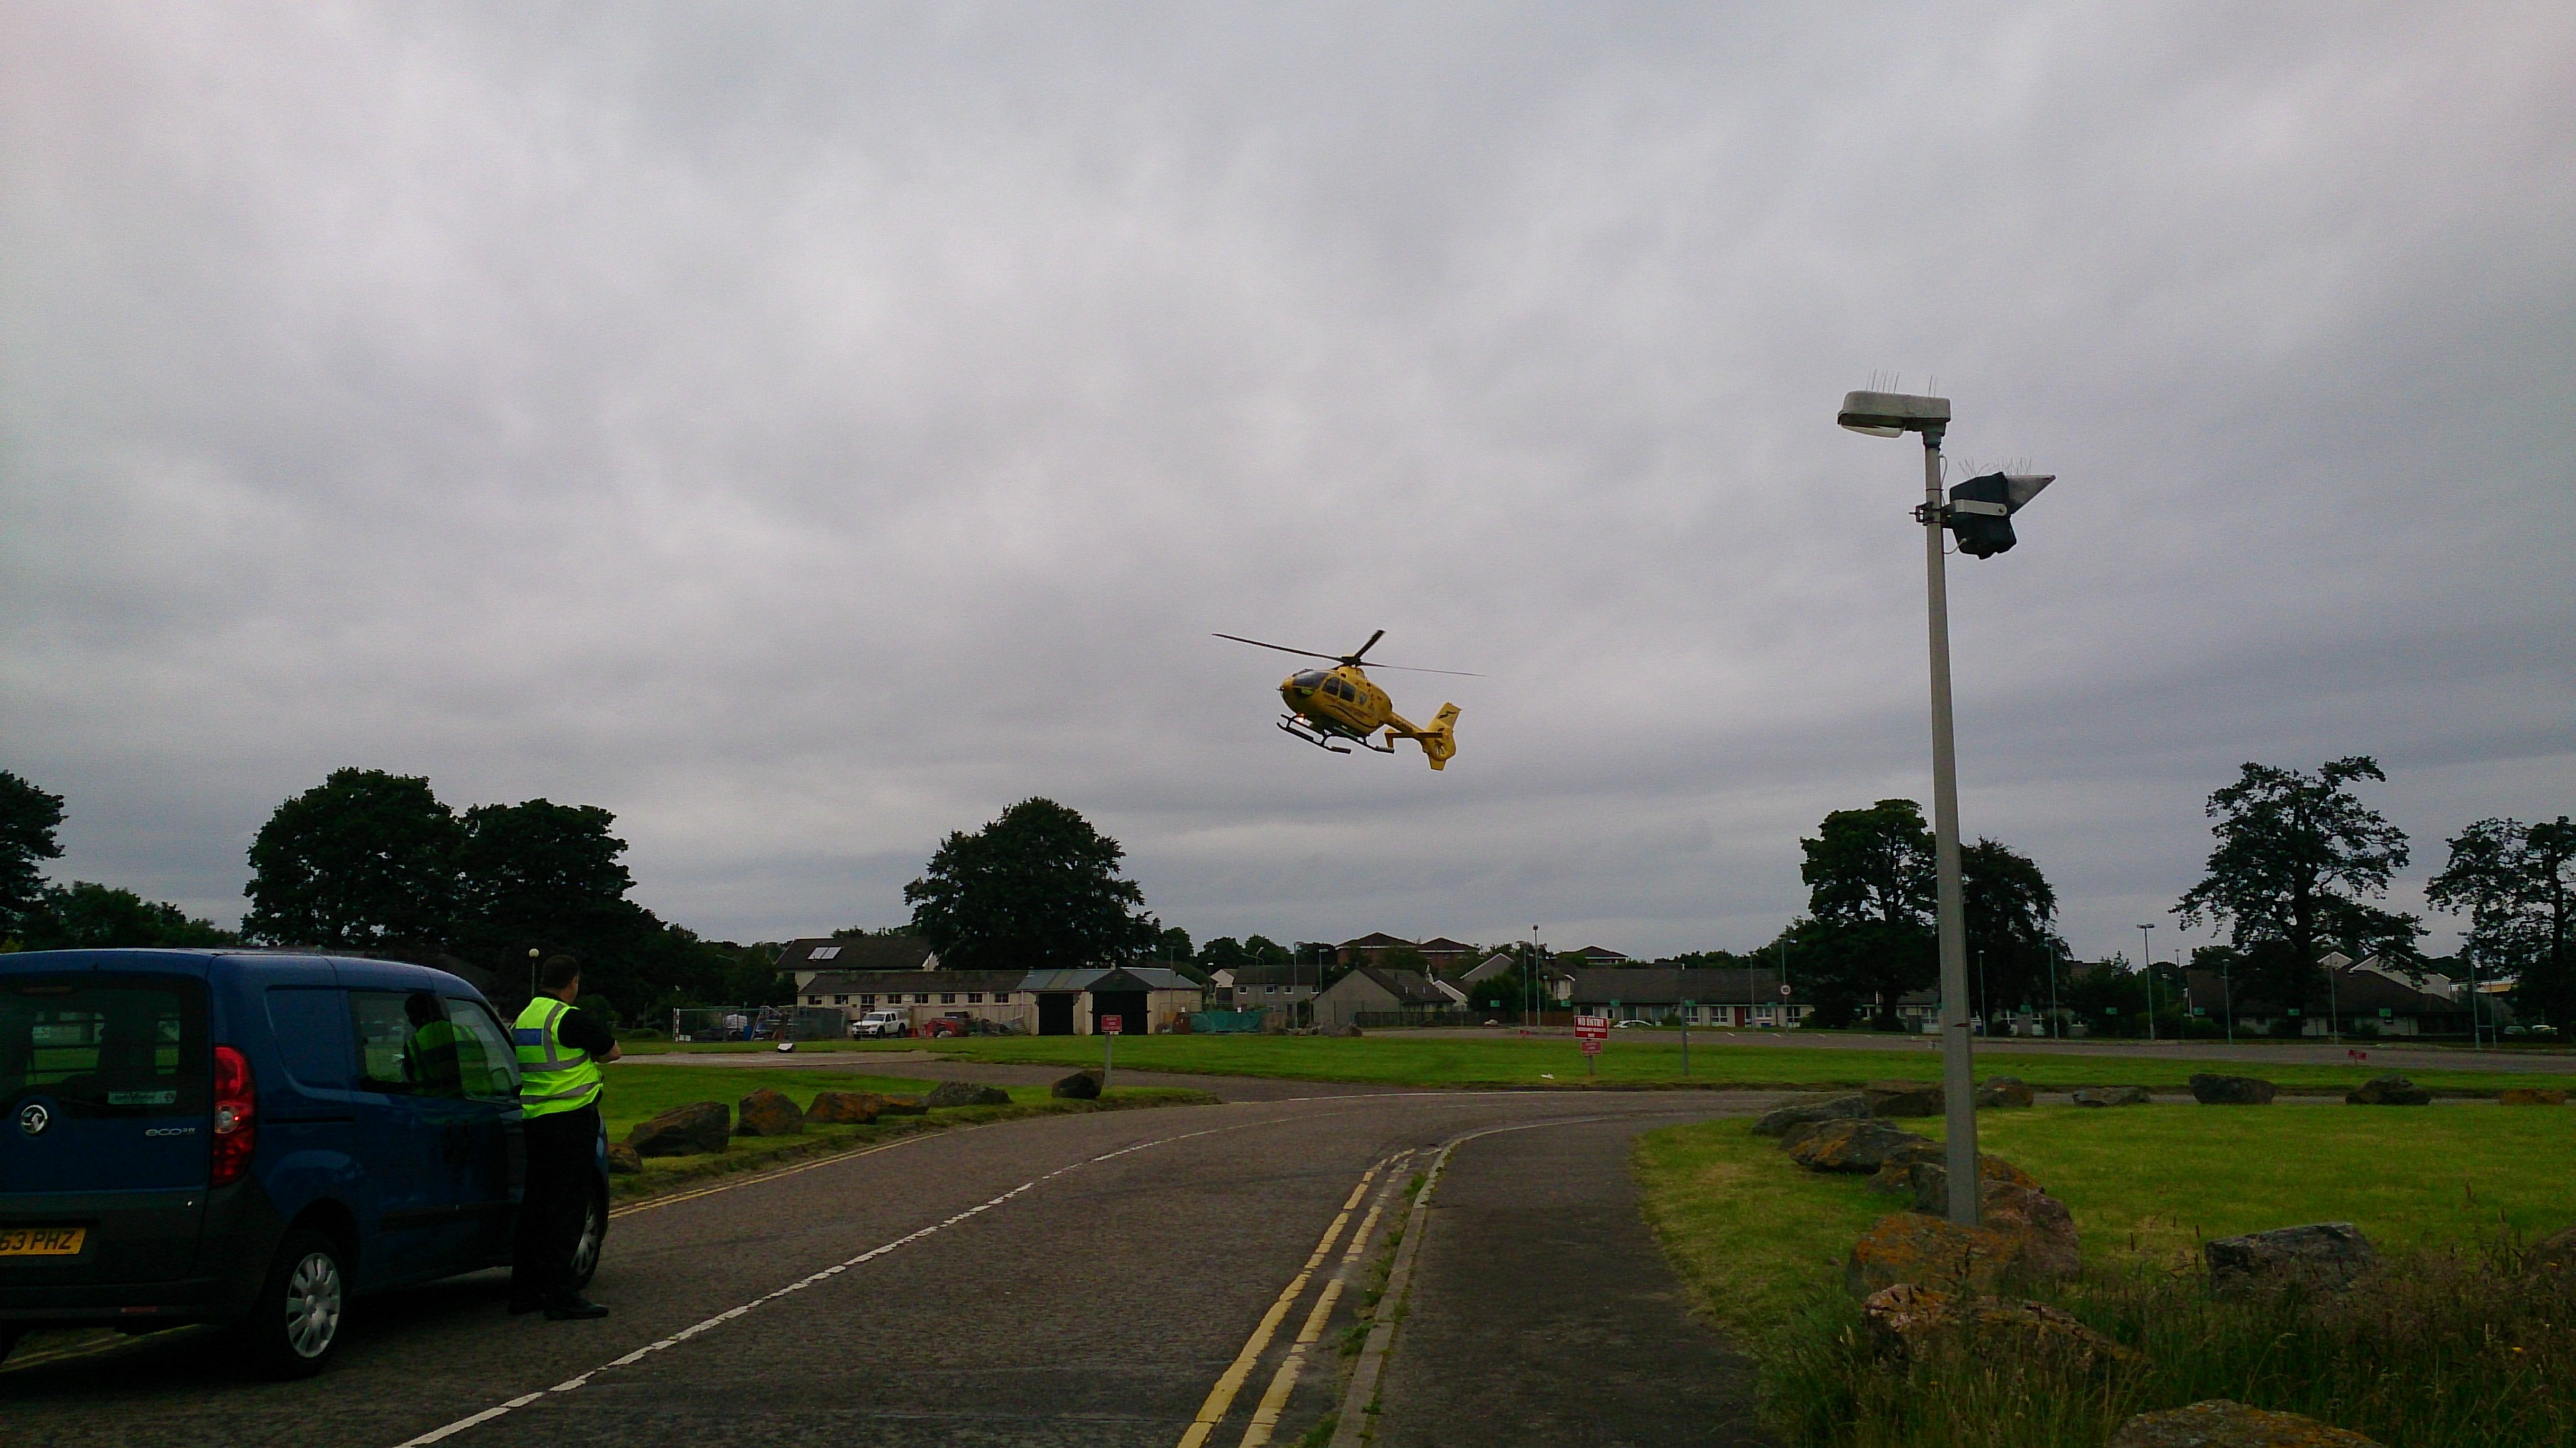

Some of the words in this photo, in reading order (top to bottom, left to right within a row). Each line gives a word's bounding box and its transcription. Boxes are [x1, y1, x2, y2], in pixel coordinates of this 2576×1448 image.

[1577, 1017, 1586, 1025] NO
[1587, 1017, 1604, 1027] ENTRY
[30, 1230, 76, 1250] PHZ
